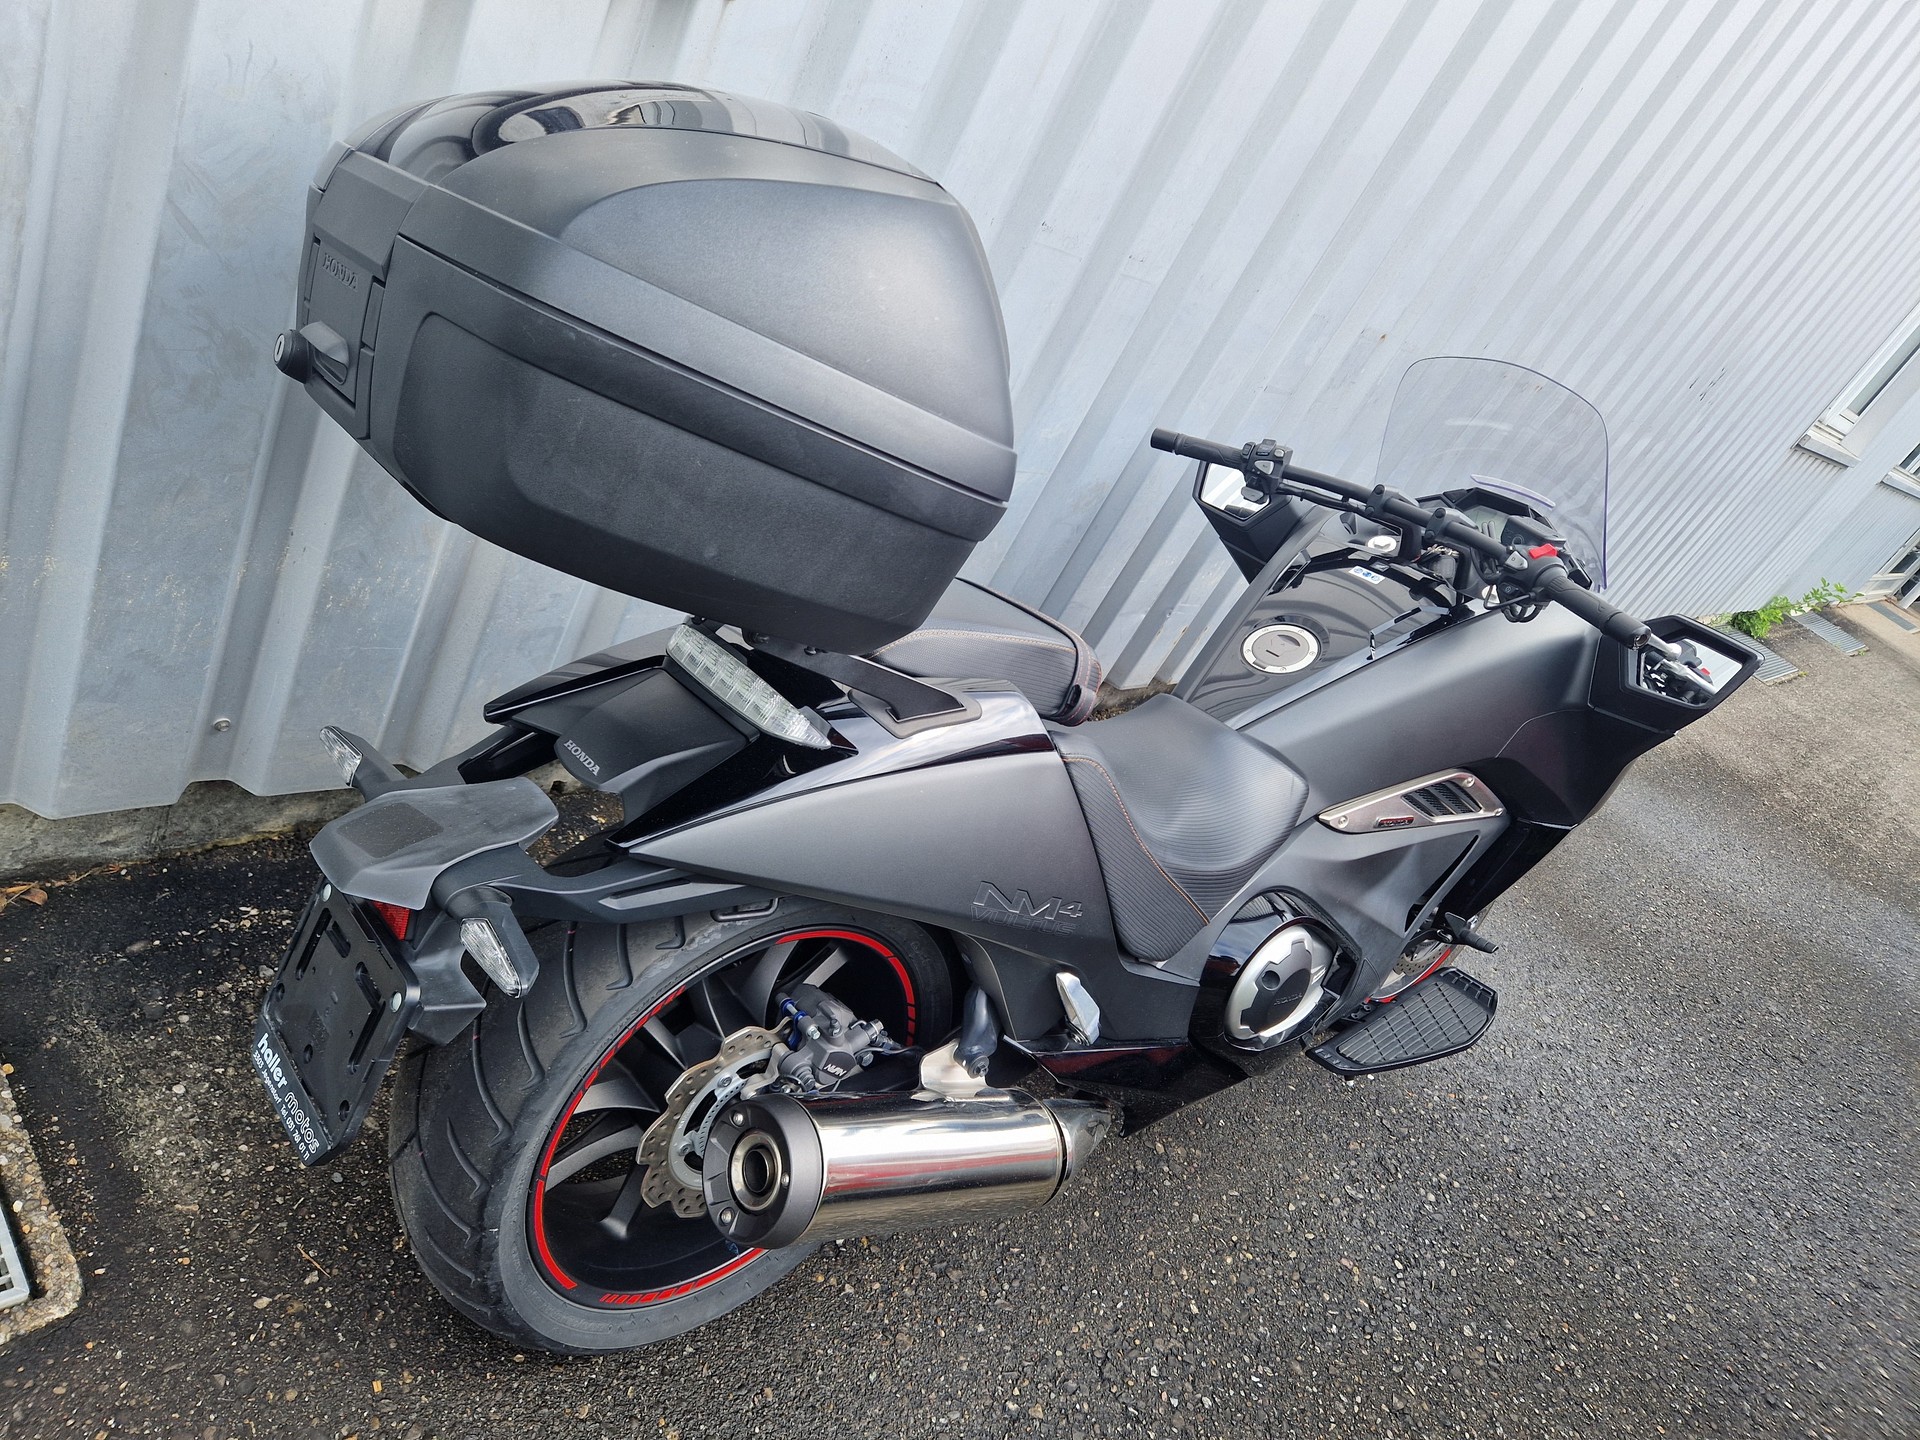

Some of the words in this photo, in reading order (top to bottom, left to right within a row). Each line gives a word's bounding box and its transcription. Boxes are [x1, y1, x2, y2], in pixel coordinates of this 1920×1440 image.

[322, 252, 358, 292] HONDA
[564, 740, 600, 776] HONDA
[970, 904, 1077, 936] VULTUS
[972, 880, 1083, 921] NM4
[257, 1032, 288, 1089] haller
[284, 1091, 320, 1154] motos
